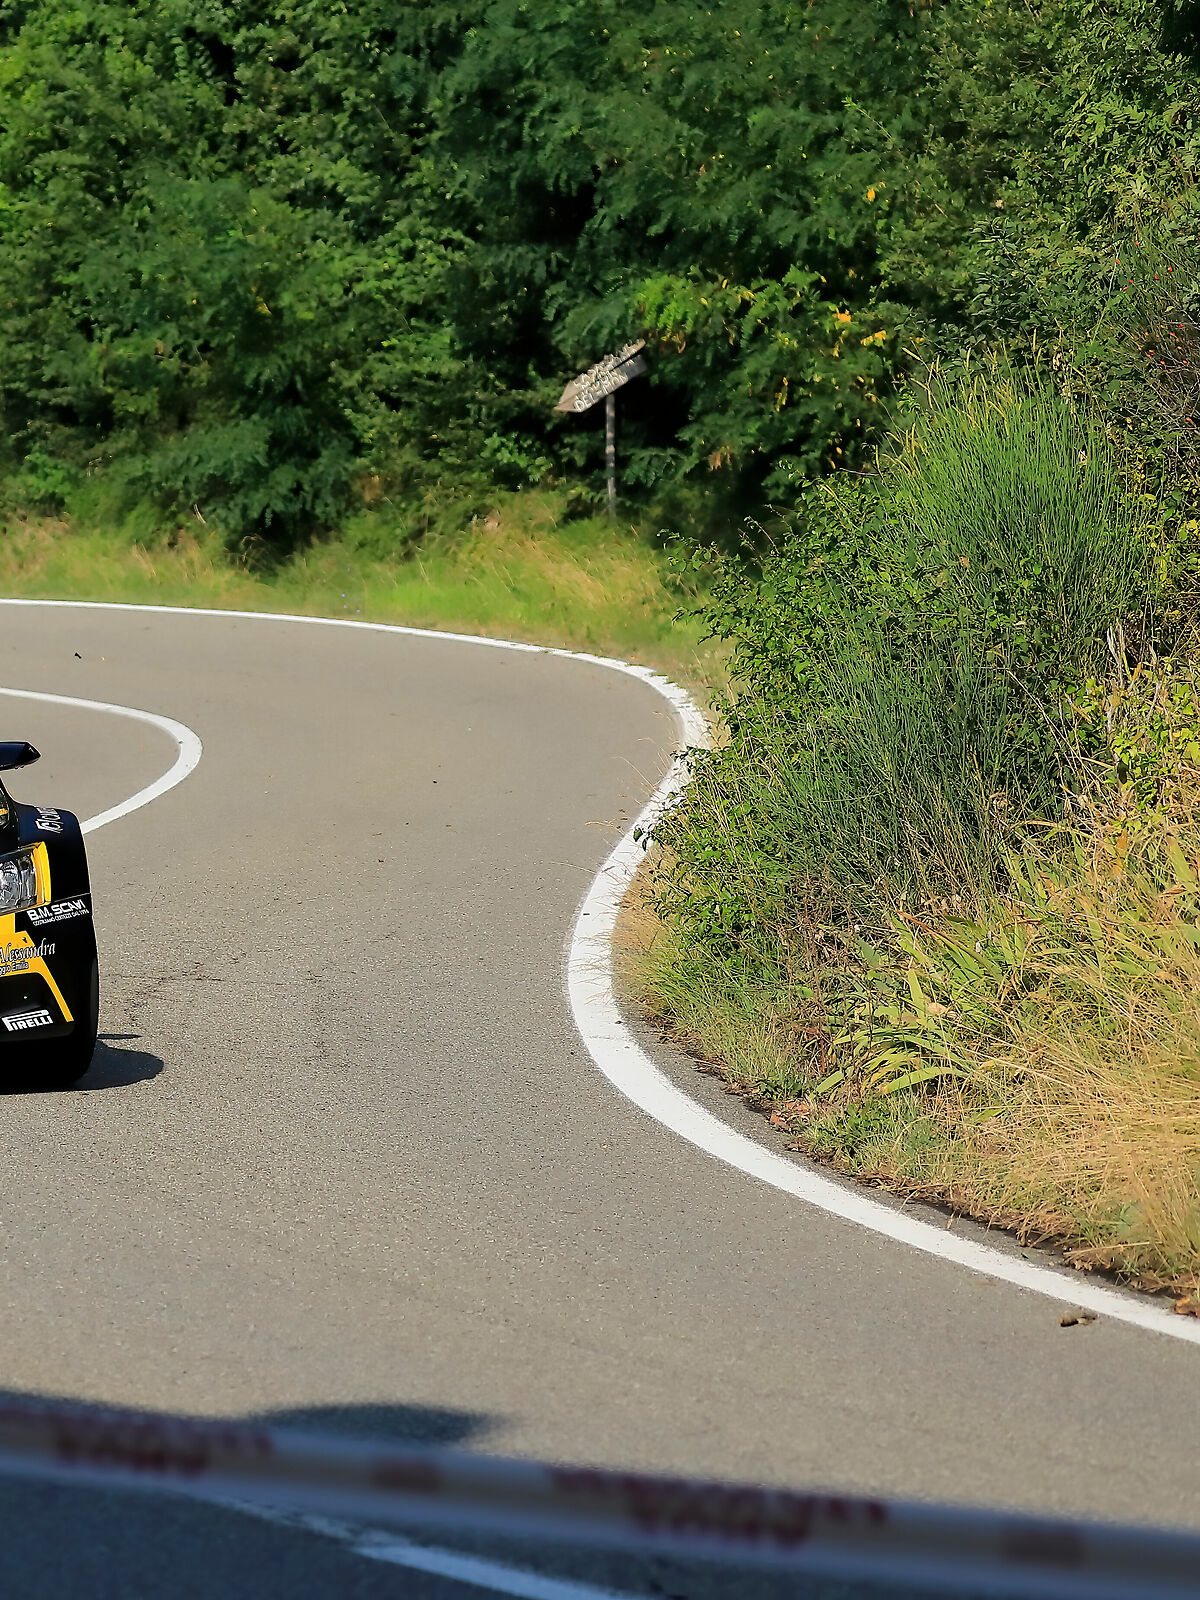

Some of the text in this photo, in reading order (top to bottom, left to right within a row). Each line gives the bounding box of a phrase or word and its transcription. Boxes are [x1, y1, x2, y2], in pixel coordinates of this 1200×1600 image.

[26, 906, 53, 921] B.M.
[51, 899, 87, 915] SCAVI
[12, 960, 29, 972] Emilia
[1, 1009, 54, 1032] PIRELLI
